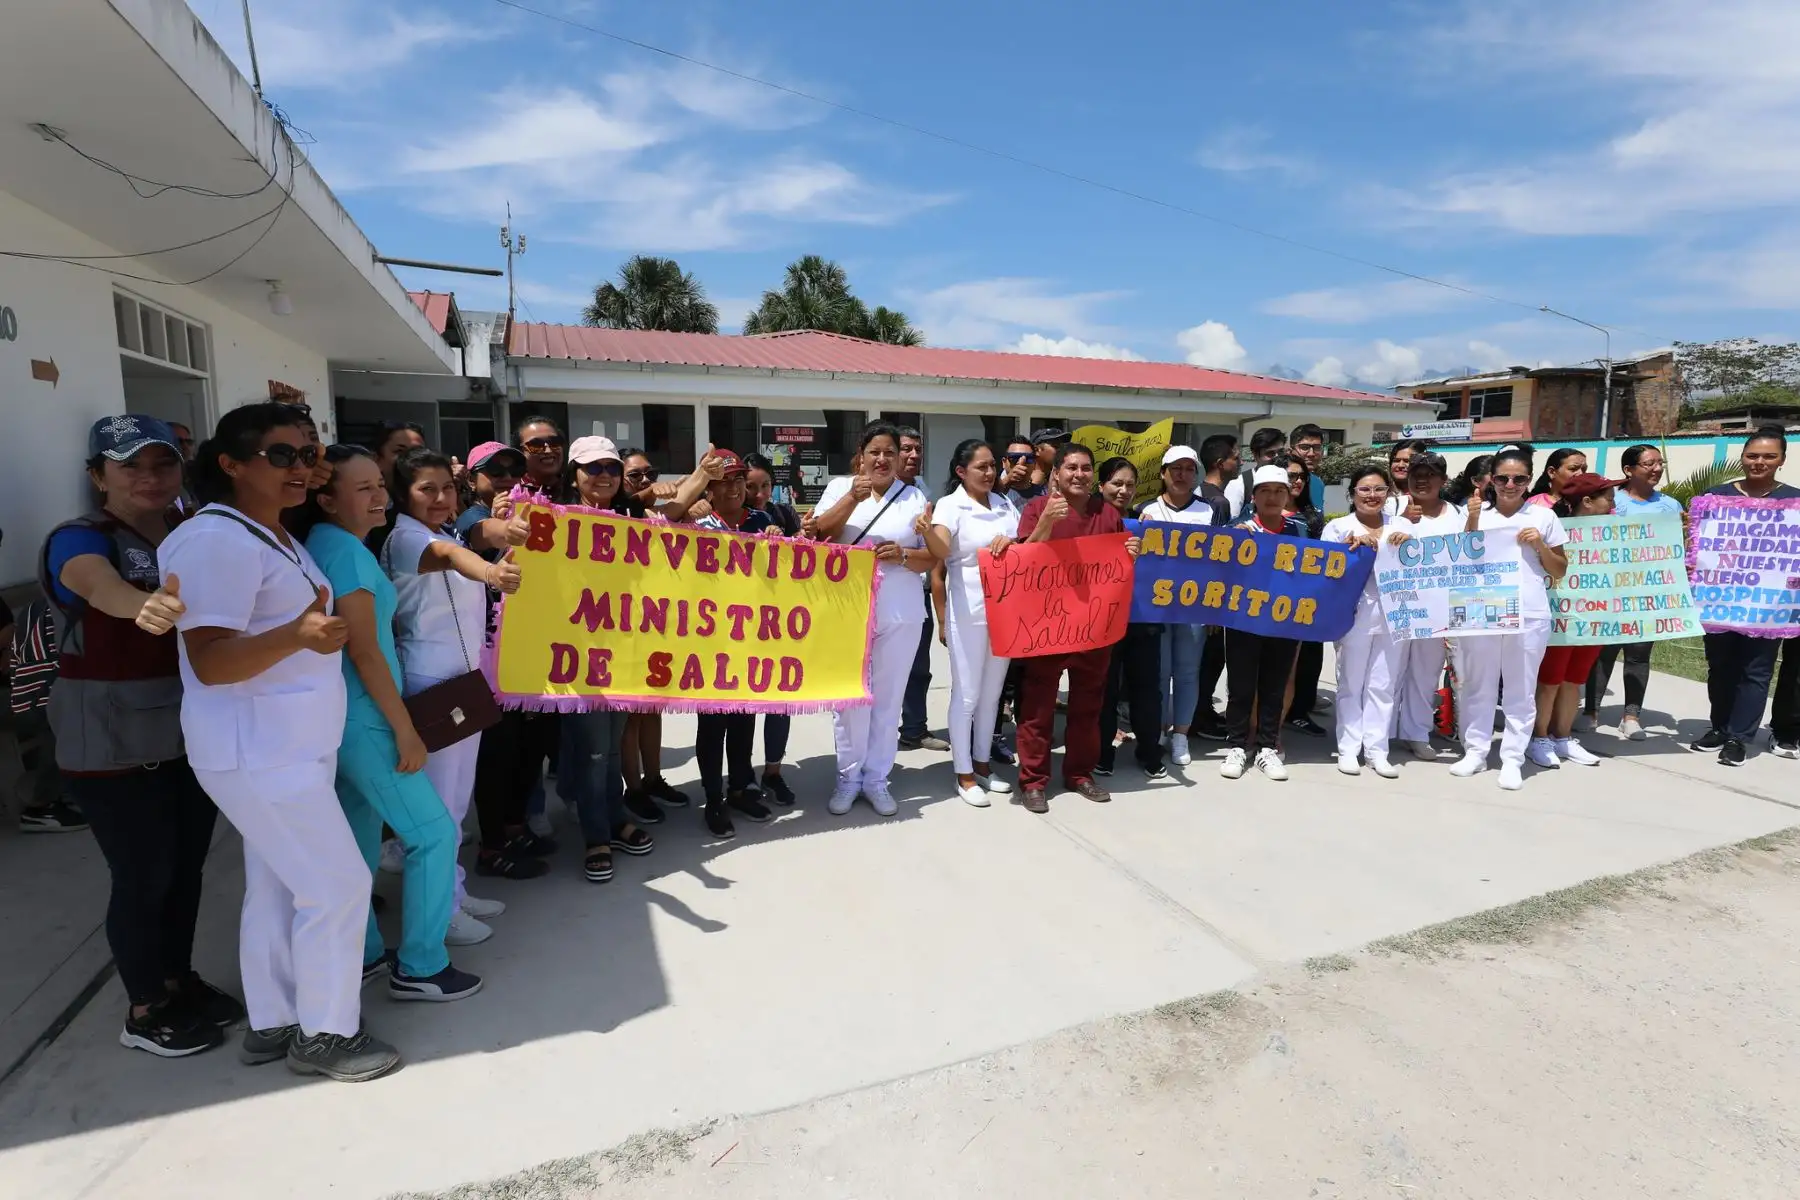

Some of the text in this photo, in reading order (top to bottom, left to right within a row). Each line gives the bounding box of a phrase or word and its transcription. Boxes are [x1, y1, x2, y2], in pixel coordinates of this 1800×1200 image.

[1700, 507, 1785, 522] JUNTOS
[1592, 524, 1655, 541] HOSPITAL
[525, 511, 849, 583] BIENVENIDO
[1140, 528, 1347, 579] MICRO RED
[1399, 530, 1486, 567] CPVC
[1565, 544, 1683, 566] E HACE REALIDAD
[1403, 566, 1449, 579] MARCOS
[1418, 578, 1434, 589] LA
[1438, 575, 1477, 587] SALUD
[1483, 574, 1501, 585] ES
[1544, 575, 1564, 591] OR
[1569, 572, 1611, 590] OBRA
[1632, 569, 1676, 586] MAGIA
[1152, 579, 1317, 625] SORITOR
[1390, 590, 1419, 602] VIDA
[1550, 598, 1571, 613] NO
[569, 588, 812, 641] MINISTRO
[1033, 591, 1070, 627] la
[1575, 620, 1588, 636] Y
[548, 642, 804, 693] DE SALUD
